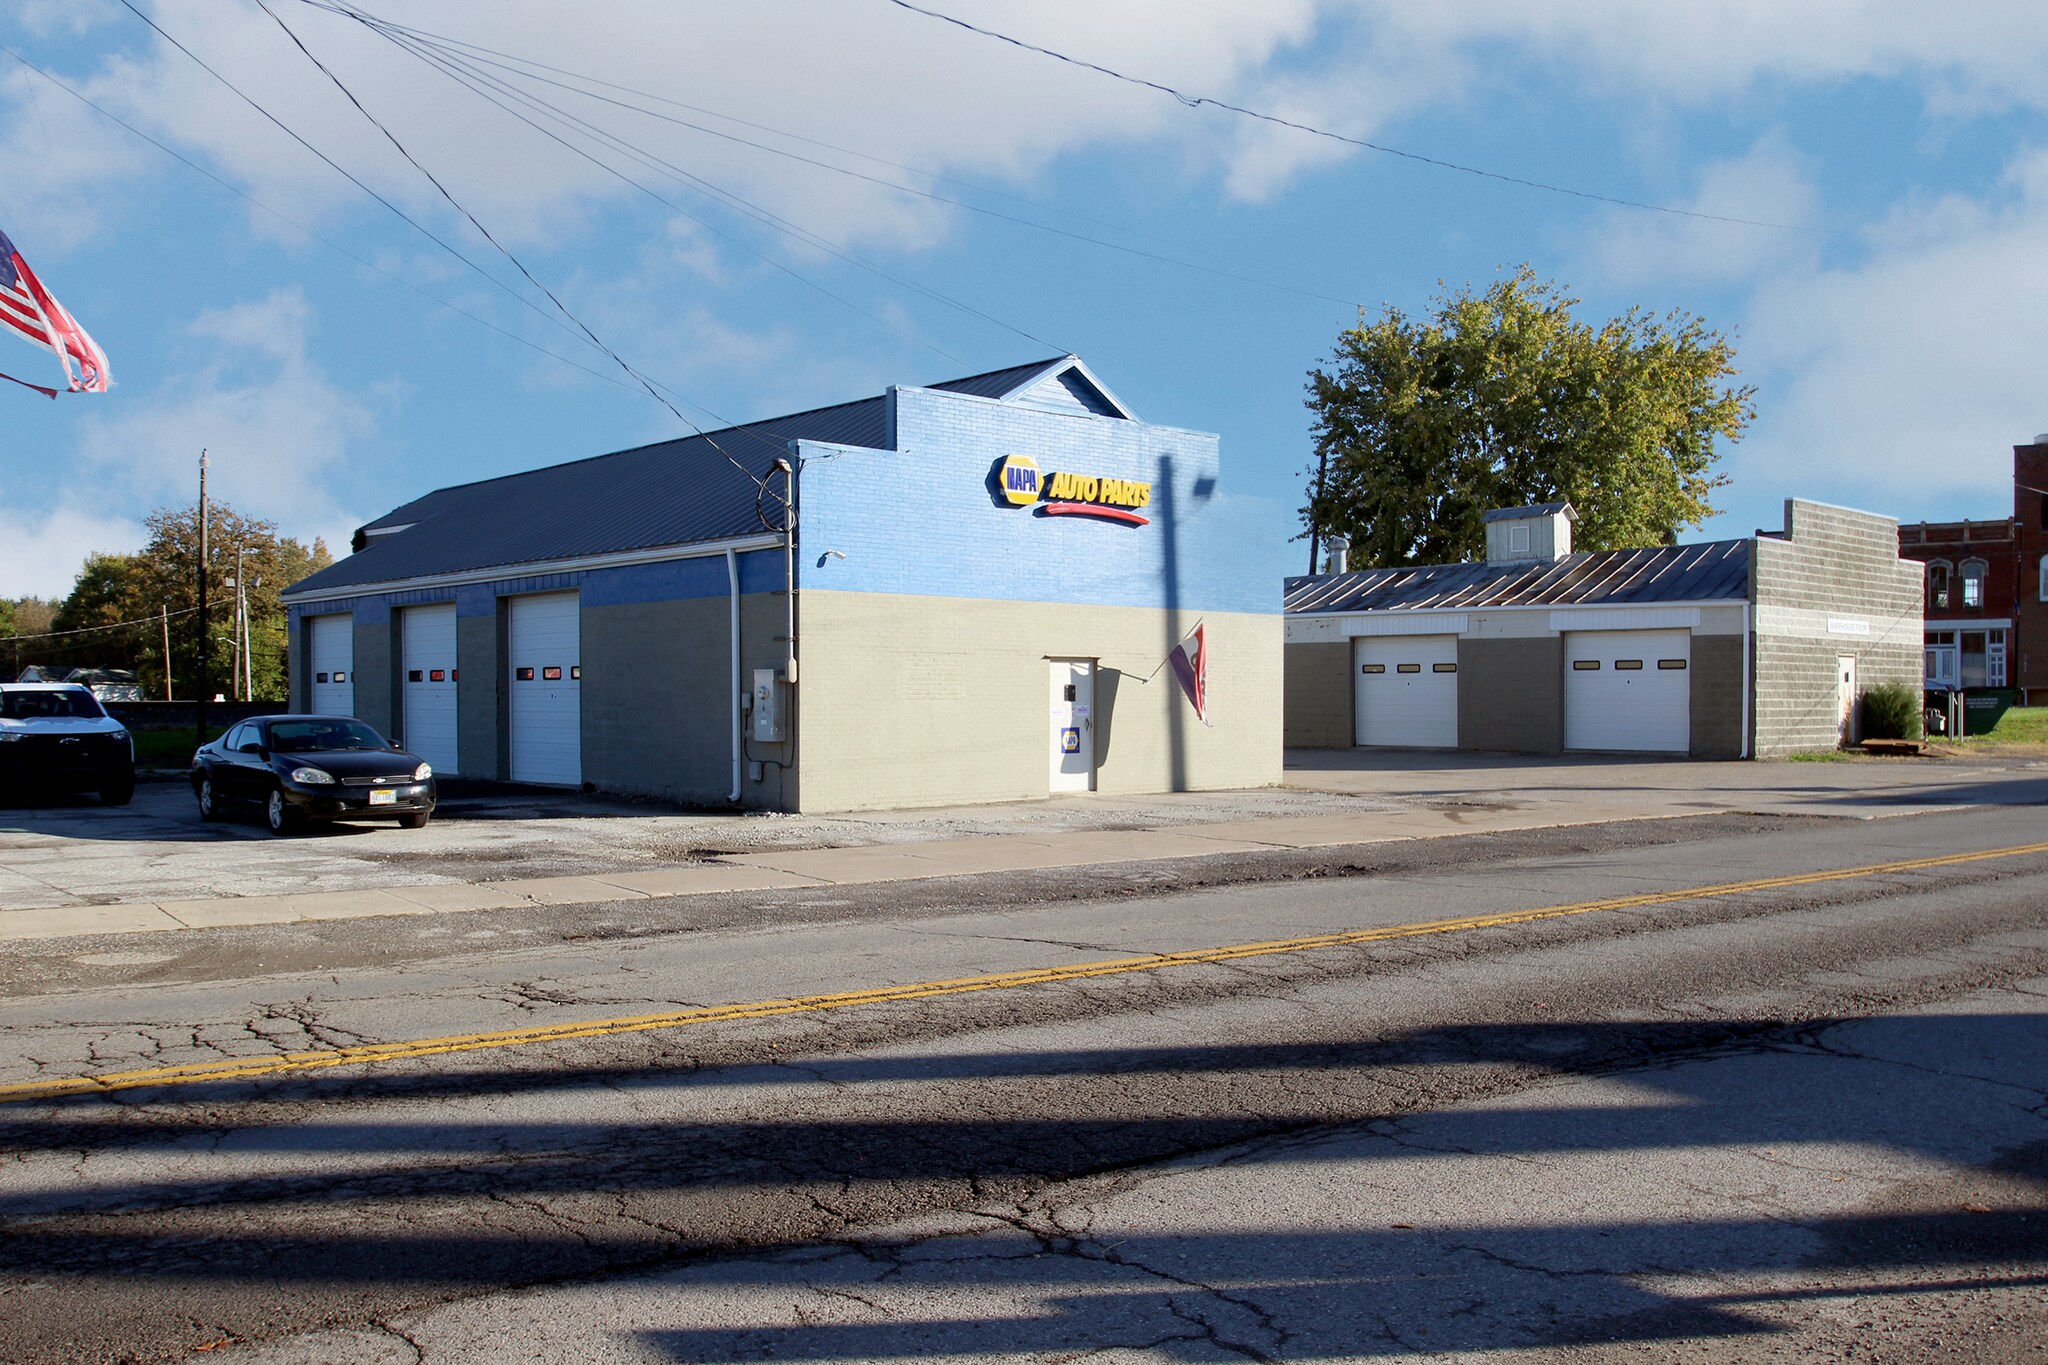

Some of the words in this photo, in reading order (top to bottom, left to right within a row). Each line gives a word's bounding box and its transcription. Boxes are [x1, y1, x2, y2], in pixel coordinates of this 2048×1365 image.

[1007, 467, 1037, 492] NAPA
[1049, 472, 1098, 502] AUTO
[1099, 478, 1151, 507] PARTS
